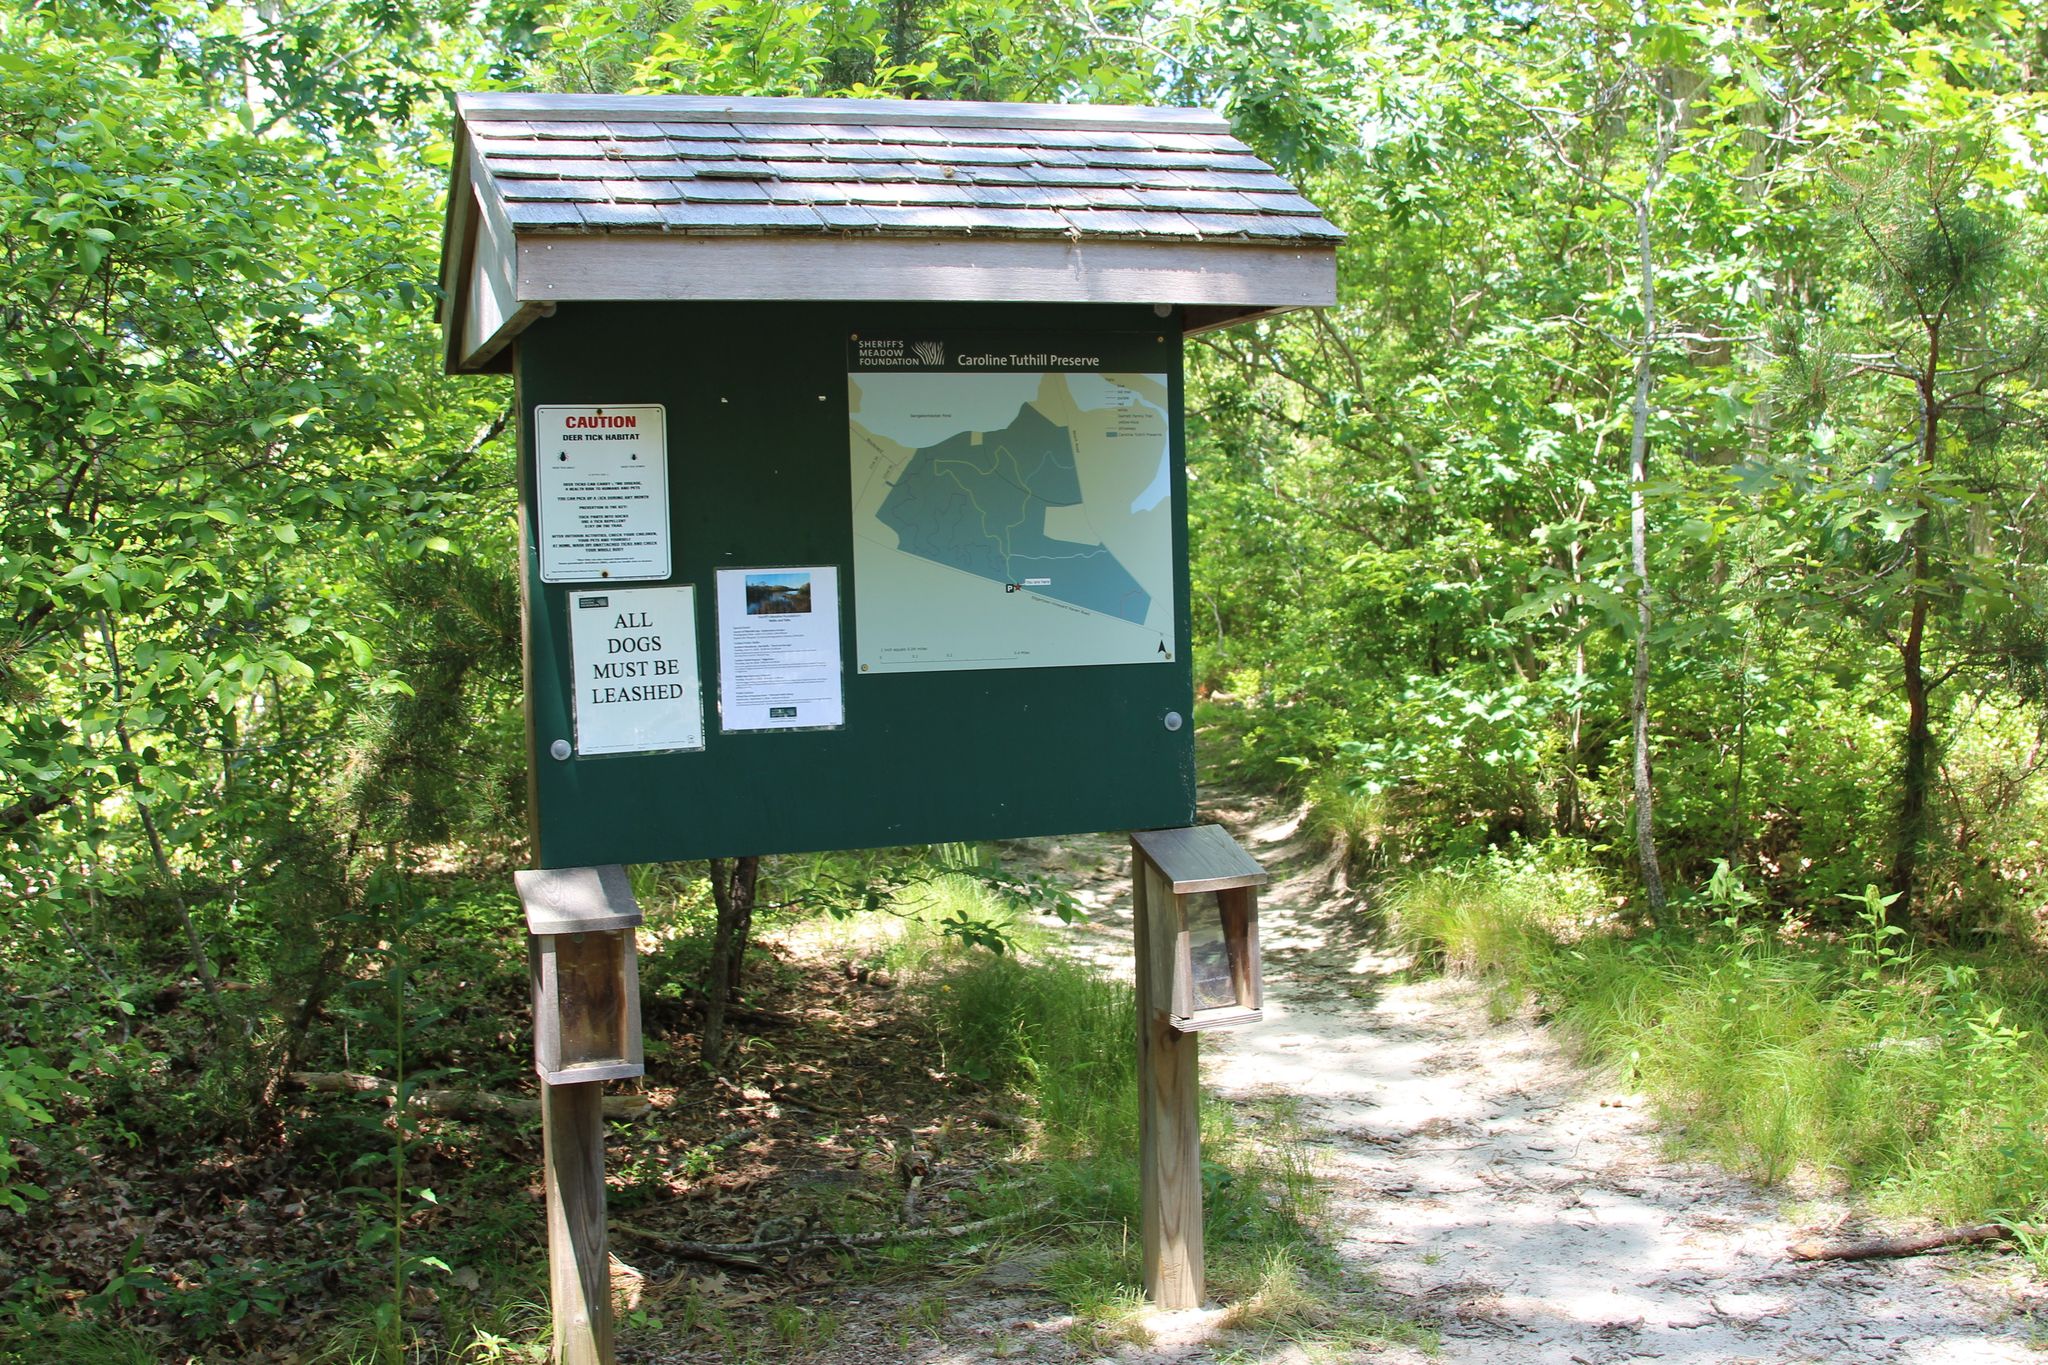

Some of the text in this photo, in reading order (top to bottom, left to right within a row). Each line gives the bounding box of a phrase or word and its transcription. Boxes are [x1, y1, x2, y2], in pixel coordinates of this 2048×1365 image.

[958, 355, 1100, 366] Caroline Tuthill Preserve
[566, 416, 636, 428] CAUTION
[614, 612, 653, 629] ALL
[608, 636, 662, 654] DOGS
[593, 659, 680, 679] MUST BE
[592, 684, 683, 704] LEASHED
